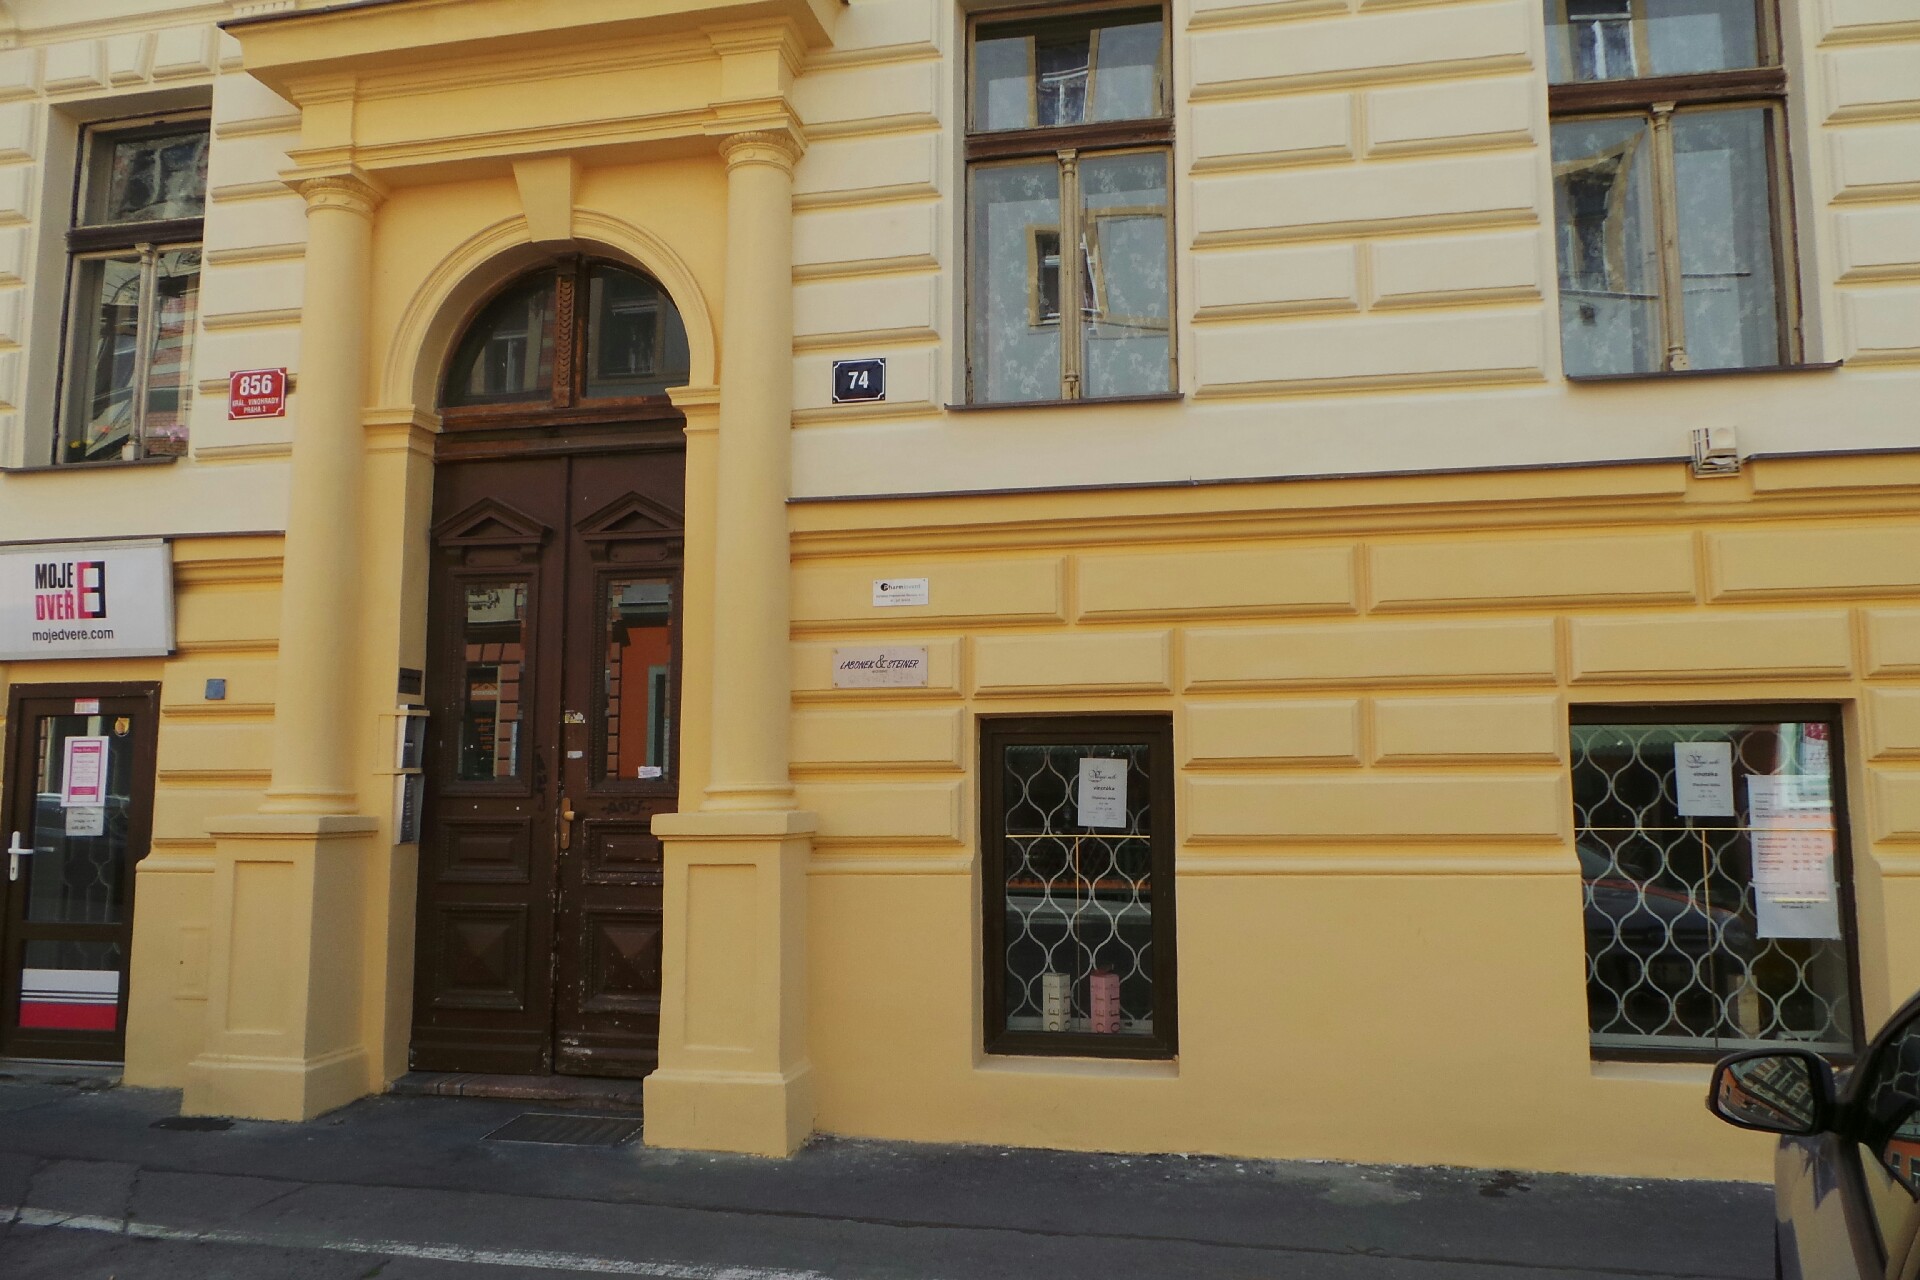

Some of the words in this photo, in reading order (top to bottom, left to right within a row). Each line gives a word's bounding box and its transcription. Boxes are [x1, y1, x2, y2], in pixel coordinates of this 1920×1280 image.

[240, 375, 272, 395] 856
[848, 371, 868, 389] 74
[248, 397, 279, 406] VINOHRADY
[35, 563, 73, 589] MOJE
[32, 629, 114, 643] mojedvere.com
[875, 654, 888, 669] &
[887, 660, 919, 669] STEINER
